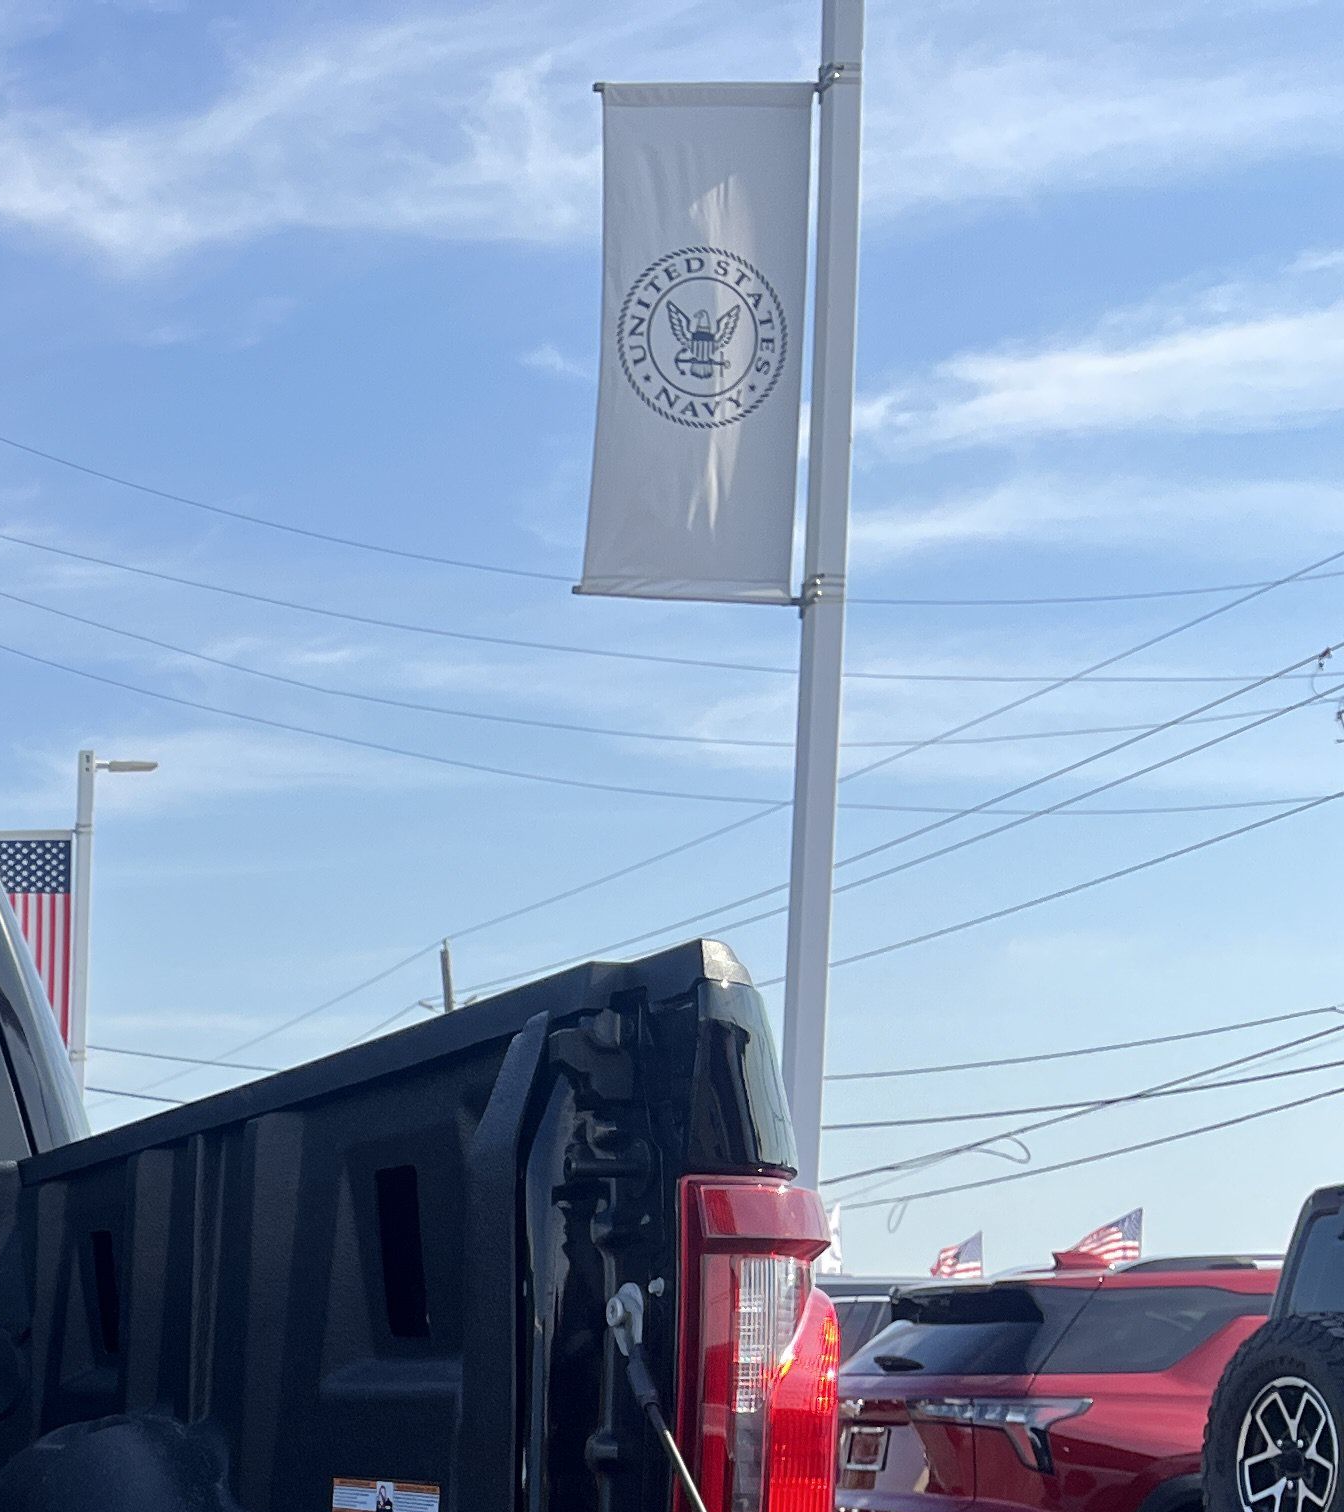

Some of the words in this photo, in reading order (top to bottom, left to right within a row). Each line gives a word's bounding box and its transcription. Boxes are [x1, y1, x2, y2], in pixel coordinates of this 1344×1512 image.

[629, 257, 705, 365] UNITED
[714, 260, 775, 376] STATES
[655, 386, 743, 418] NAVY
